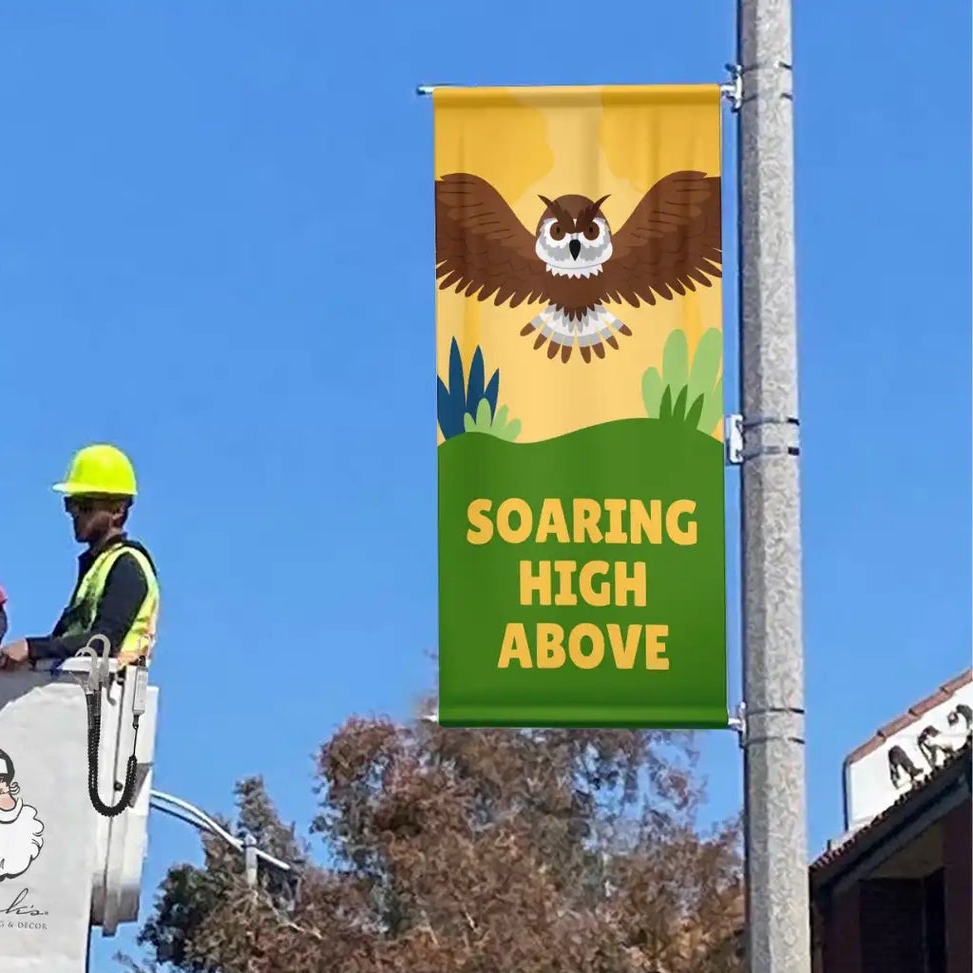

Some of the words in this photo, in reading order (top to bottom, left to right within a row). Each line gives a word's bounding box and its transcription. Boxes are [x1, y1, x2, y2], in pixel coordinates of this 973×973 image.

[466, 497, 698, 546] SOARING
[519, 560, 647, 607] HIGH
[497, 622, 670, 671] ABOVE
[7, 921, 14, 929] &
